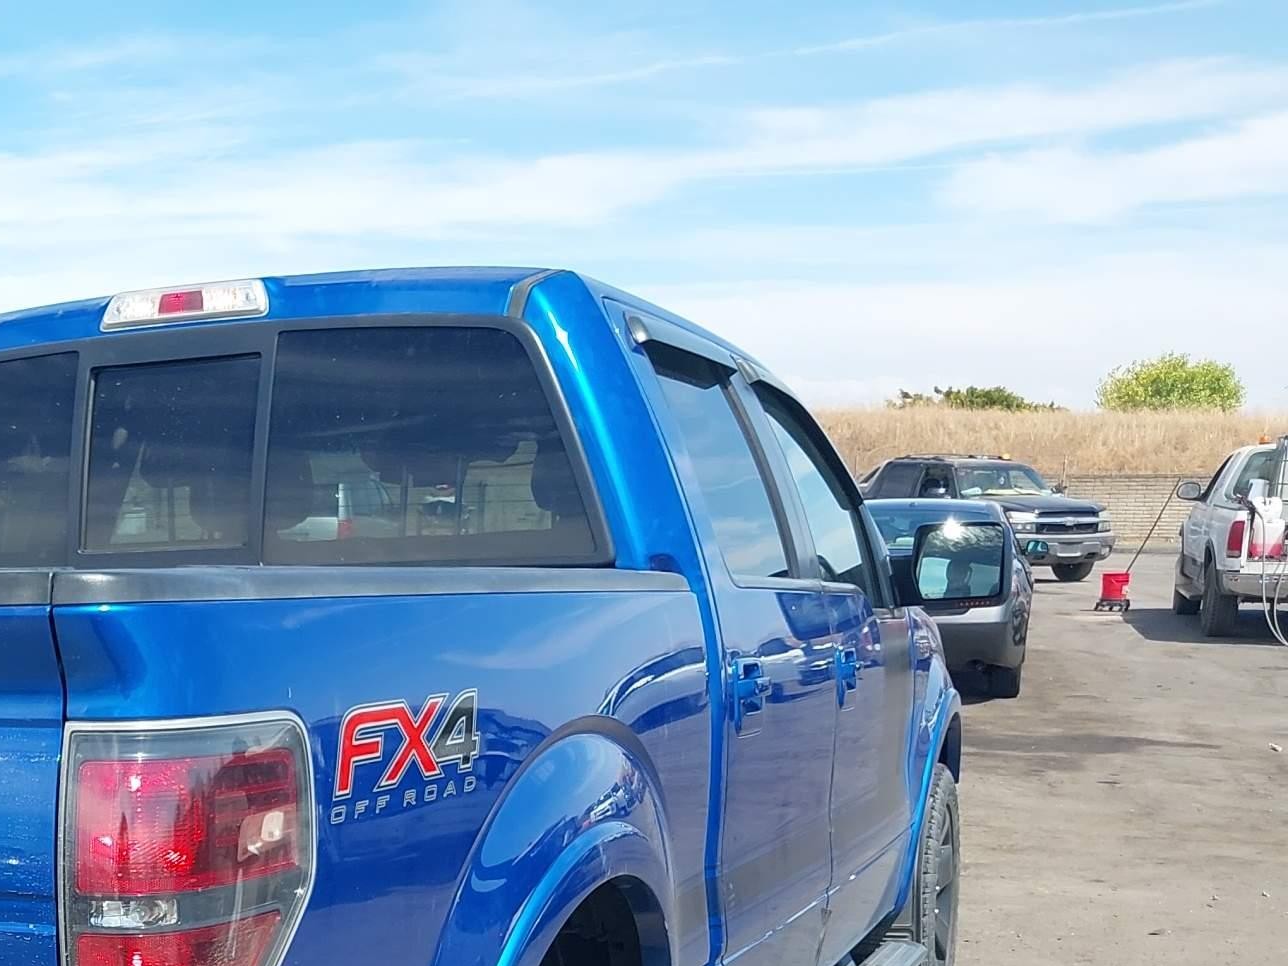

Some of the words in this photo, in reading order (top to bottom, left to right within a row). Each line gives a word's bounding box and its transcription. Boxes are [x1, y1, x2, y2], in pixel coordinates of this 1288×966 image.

[332, 687, 481, 802] FX4
[330, 794, 391, 825] OFF
[402, 775, 477, 808] ROAD
